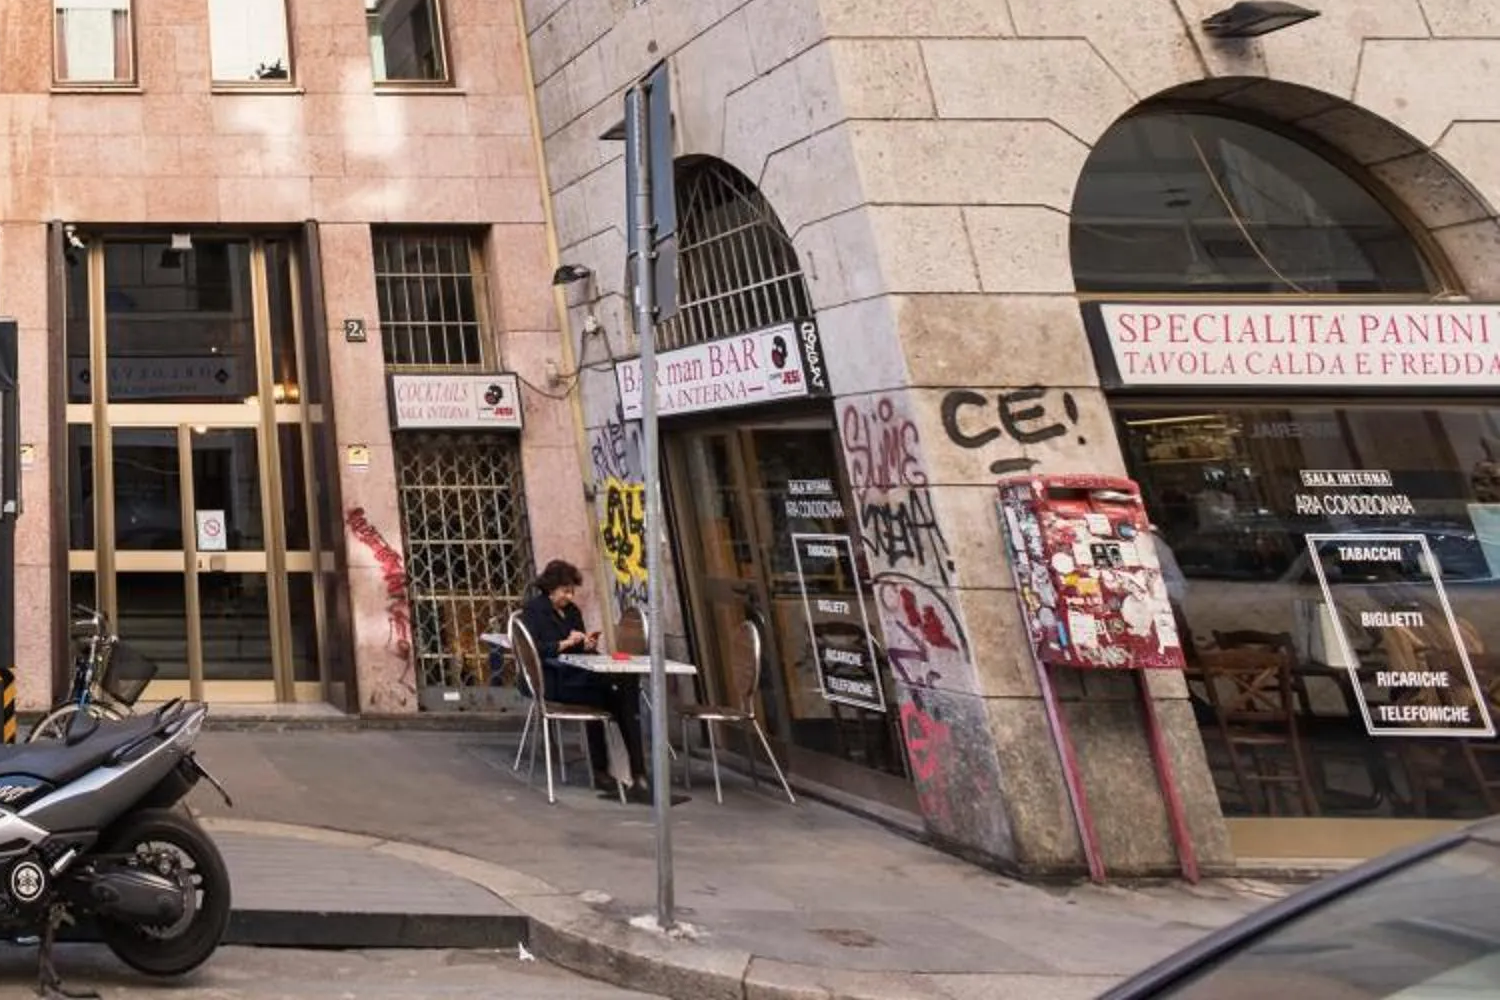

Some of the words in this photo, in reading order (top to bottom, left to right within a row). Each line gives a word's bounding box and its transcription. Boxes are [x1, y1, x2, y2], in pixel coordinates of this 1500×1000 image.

[1360, 313, 1490, 344] PANINI
[707, 337, 760, 378] BAR
[1123, 350, 1236, 376] TAVOLA
[1244, 351, 1346, 376] CALDA
[1355, 352, 1372, 376] E
[1338, 547, 1403, 561] TABACCHI
[1360, 611, 1424, 627] BIGLIETTI
[1376, 671, 1449, 687] RICARICHE
[1378, 705, 1471, 723] TELEFONICHE
